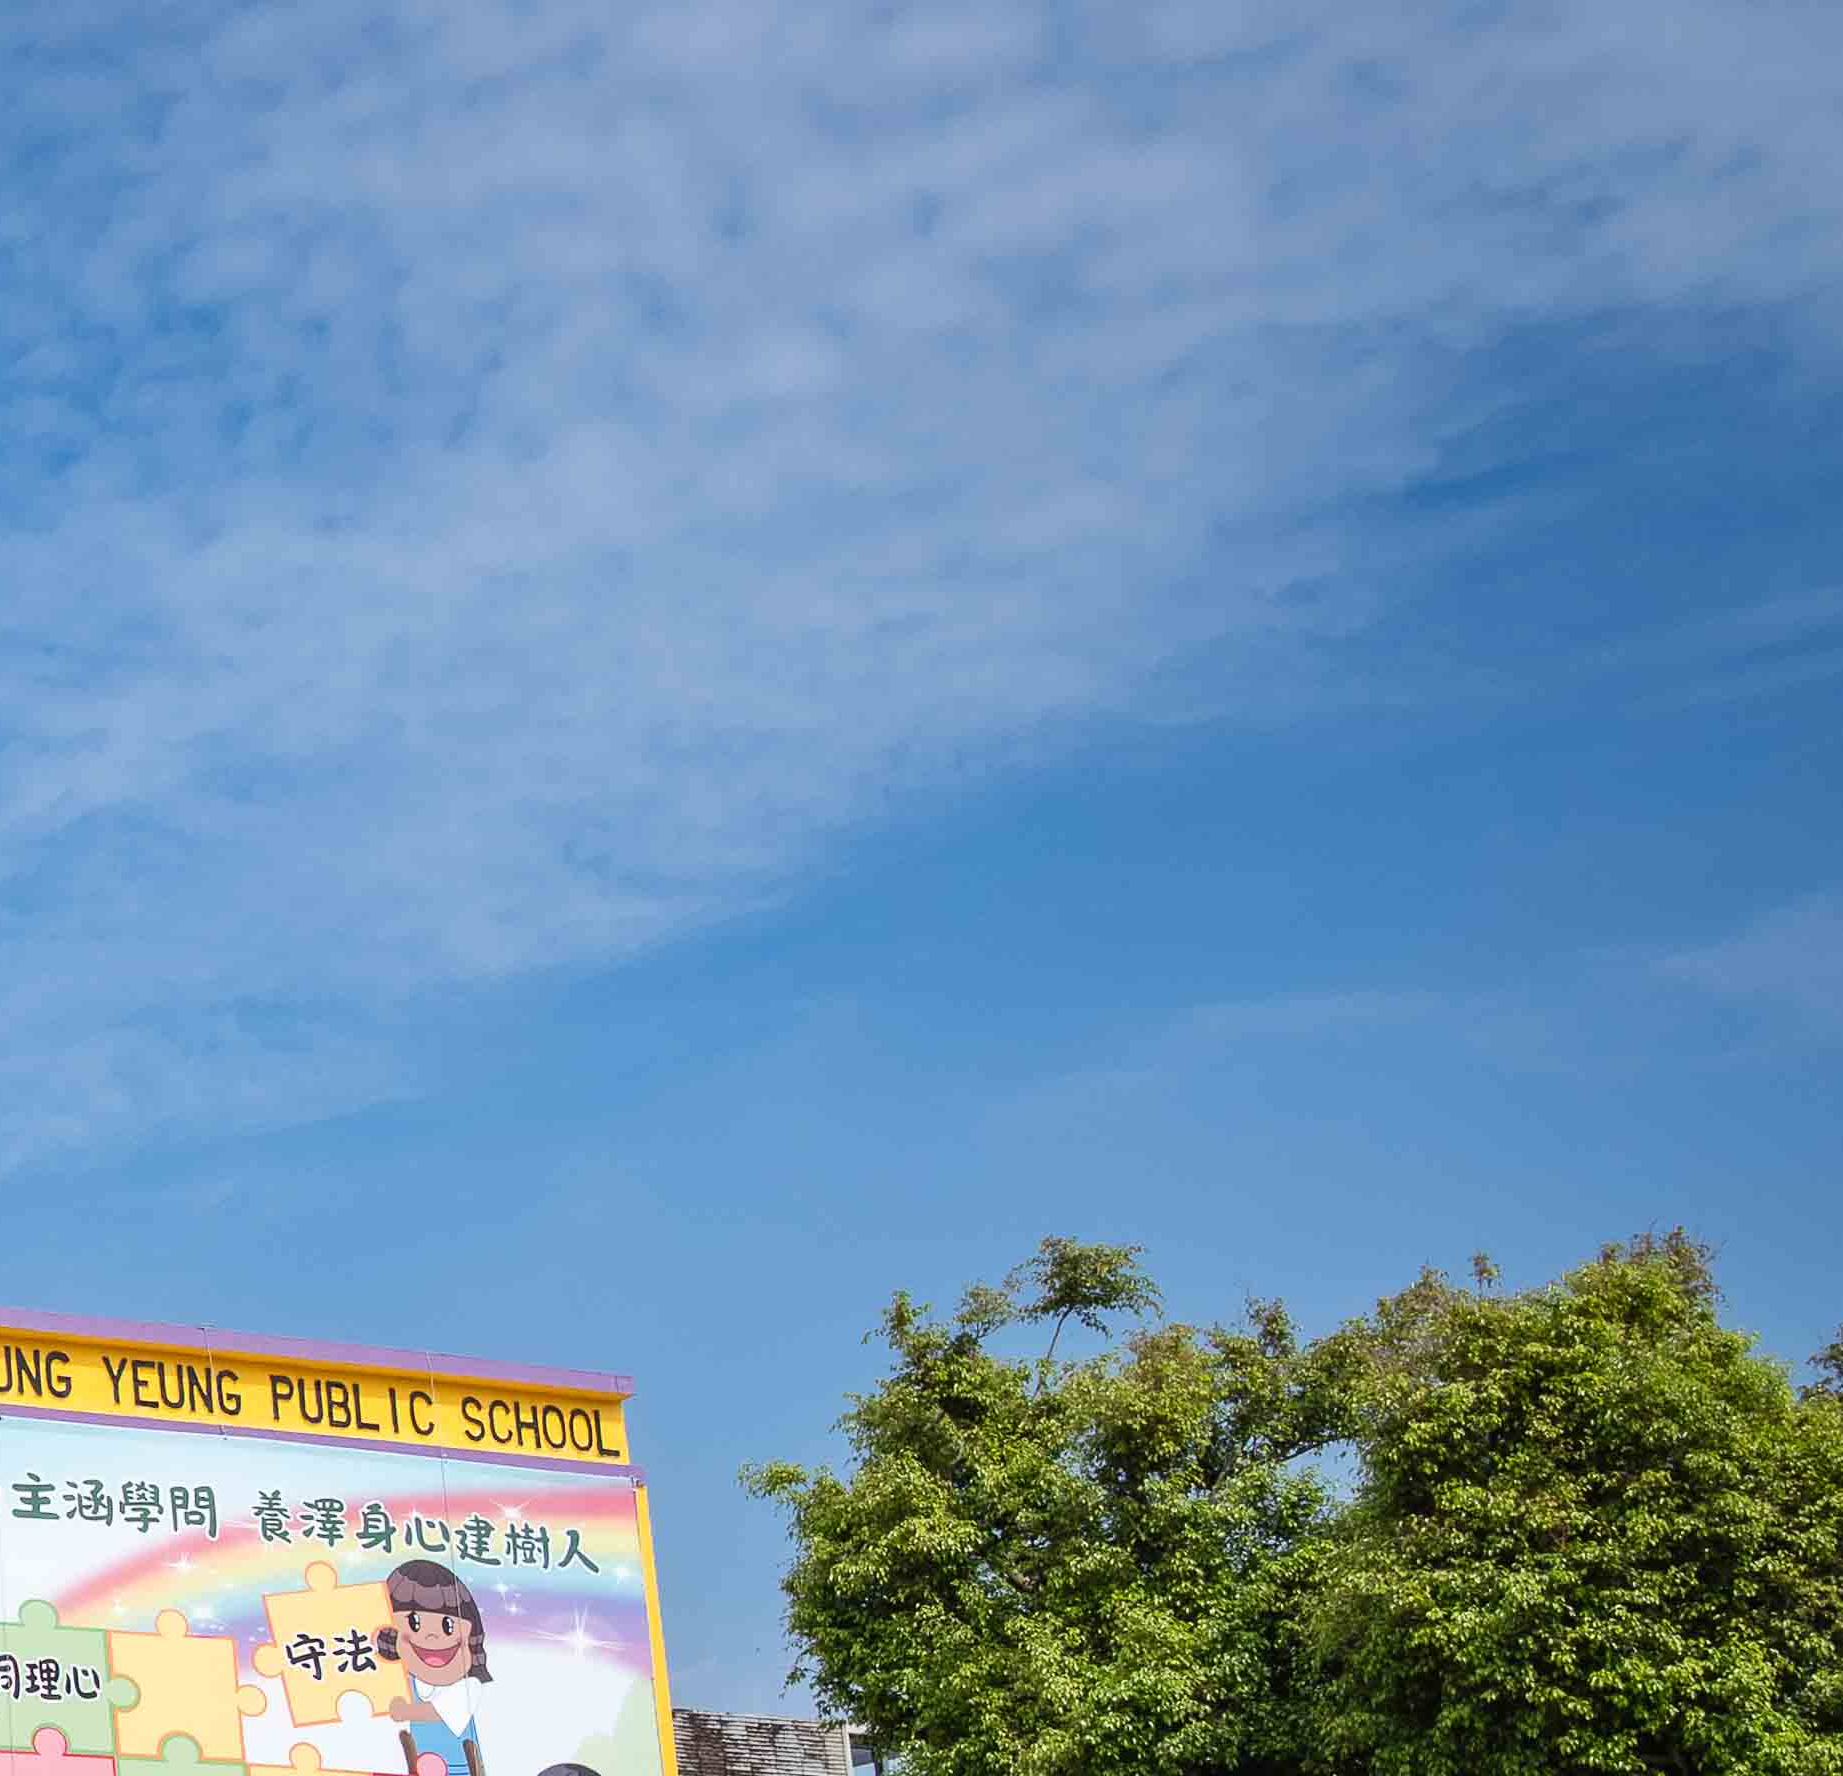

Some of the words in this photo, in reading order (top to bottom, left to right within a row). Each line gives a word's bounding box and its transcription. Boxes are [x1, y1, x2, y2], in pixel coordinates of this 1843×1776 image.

[102, 1355, 242, 1416] YEUNG
[269, 1373, 435, 1437] PUBLIC
[461, 1395, 621, 1458] SCHOOL
[250, 1489, 601, 1575] 養澤身心建樹人
[284, 1628, 380, 1680] 守法
